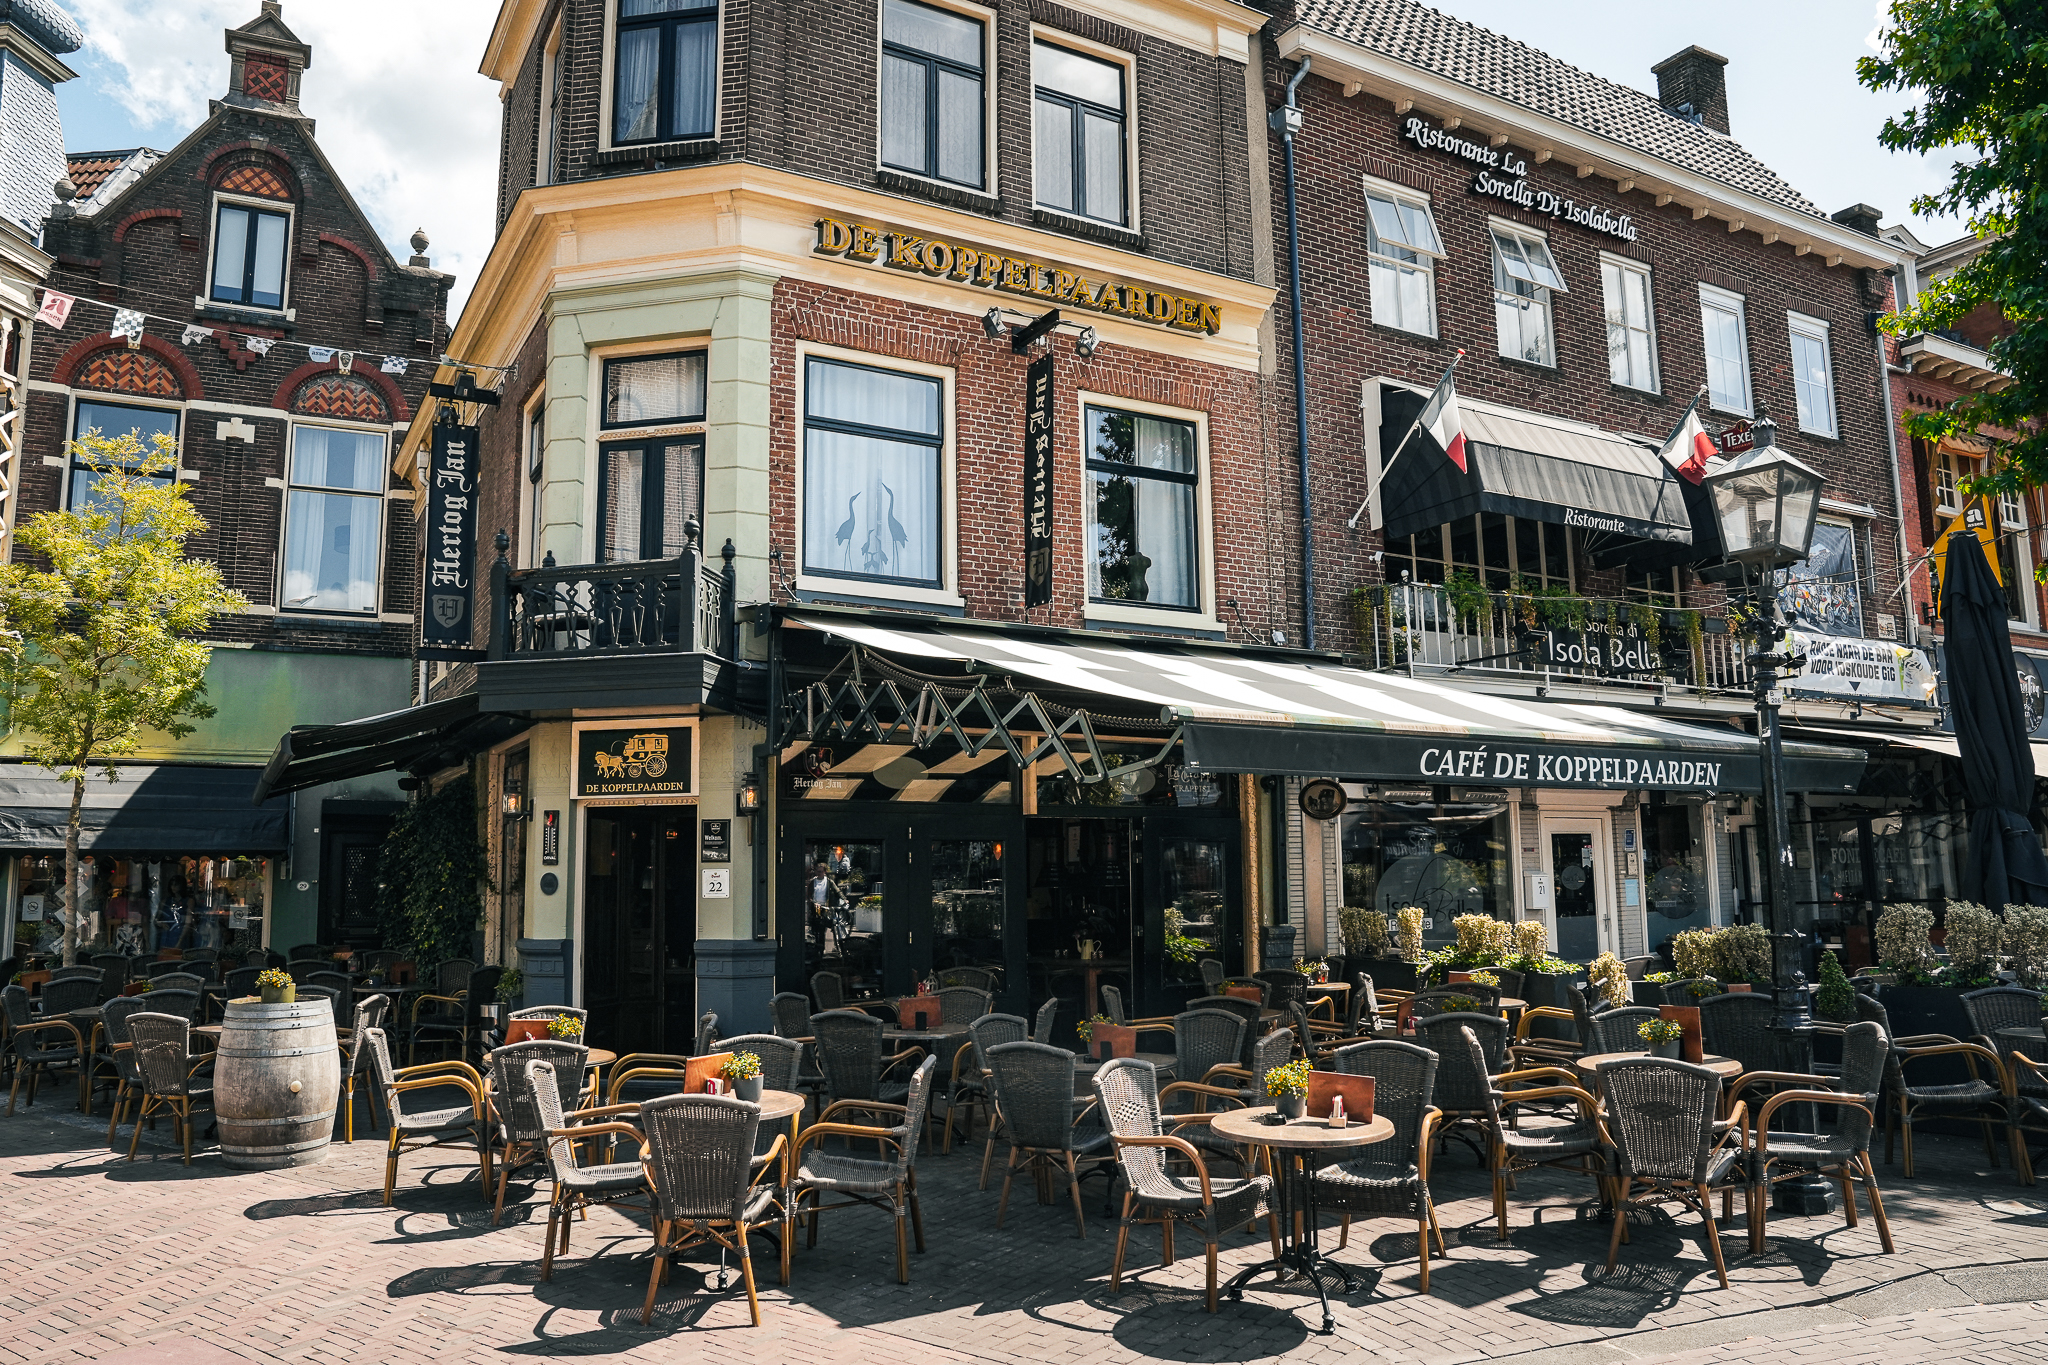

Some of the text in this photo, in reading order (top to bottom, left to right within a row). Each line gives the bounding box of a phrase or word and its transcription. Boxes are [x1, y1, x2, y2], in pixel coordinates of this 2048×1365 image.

[1405, 117, 1527, 177] Ristorante La
[1475, 171, 1638, 242] Sorella Di Isolabella
[814, 217, 1223, 335] DE KOPPELPAARDEN
[1029, 373, 1051, 540] Hertog Jan
[432, 440, 472, 589] Hertog Jan
[1563, 507, 1625, 533] Ristorante
[1627, 622, 1638, 638] di
[1548, 630, 1661, 670] Isola Bella
[1836, 643, 1861, 660] NAAR
[1862, 646, 1875, 662] DE
[1876, 648, 1894, 664] BAR
[1810, 658, 1833, 675] VOOR
[1881, 666, 1896, 682] GiG
[1164, 763, 1180, 785] La
[1419, 745, 1722, 786] CAFÉ DE KOPPELPAARDEN
[586, 781, 684, 793] DE KOPPELPAARDEN
[793, 776, 842, 790] Hertog Jan
[1173, 785, 1212, 793] TRAPPIST
[709, 882, 723, 893] 22
[1539, 885, 1546, 895] 21
